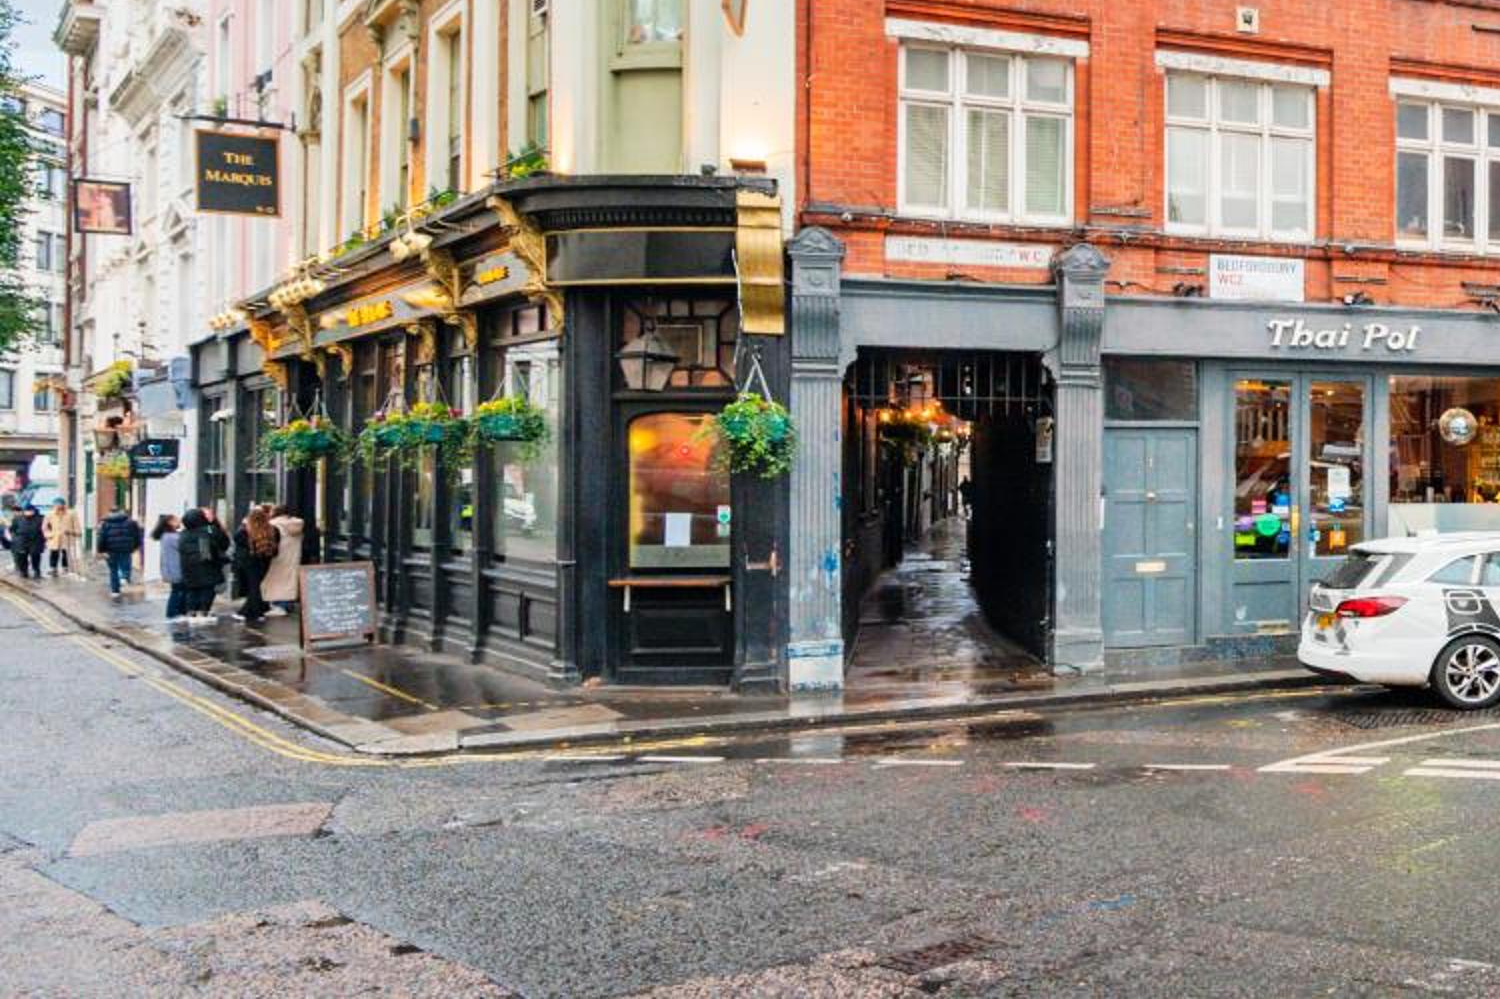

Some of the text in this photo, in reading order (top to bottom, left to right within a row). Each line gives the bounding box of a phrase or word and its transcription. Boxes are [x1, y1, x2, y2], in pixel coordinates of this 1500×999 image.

[223, 152, 255, 165] THE
[205, 169, 273, 187] MARQUIS
[1267, 318, 1352, 349] Thai
